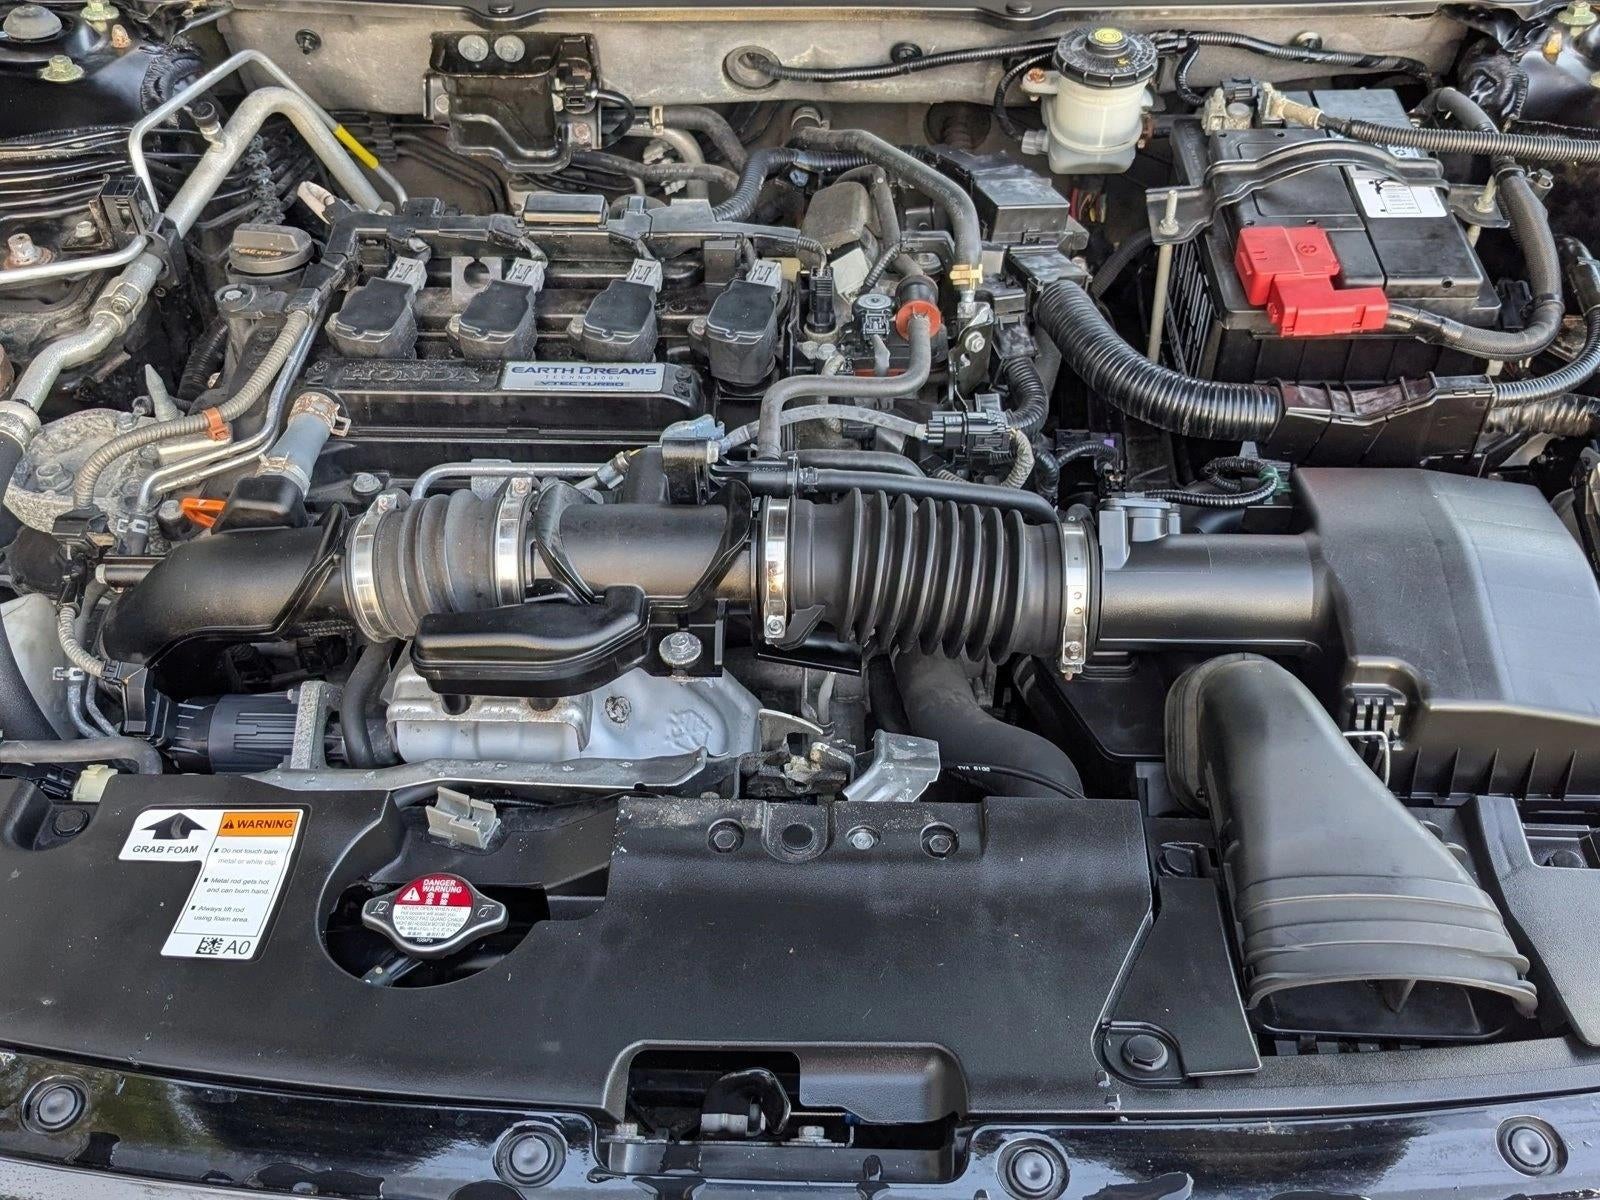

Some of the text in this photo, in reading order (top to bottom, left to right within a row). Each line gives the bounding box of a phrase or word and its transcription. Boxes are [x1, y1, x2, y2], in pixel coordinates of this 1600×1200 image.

[342, 364, 480, 383] HONDA
[511, 366, 657, 375] EARTH DREAMS
[237, 819, 294, 829] WARNING
[132, 845, 199, 853] GRAB FOAM
[423, 879, 457, 887] DANGER
[422, 885, 463, 894] WARNUNG
[197, 905, 223, 913] Always
[223, 940, 251, 955] A0
